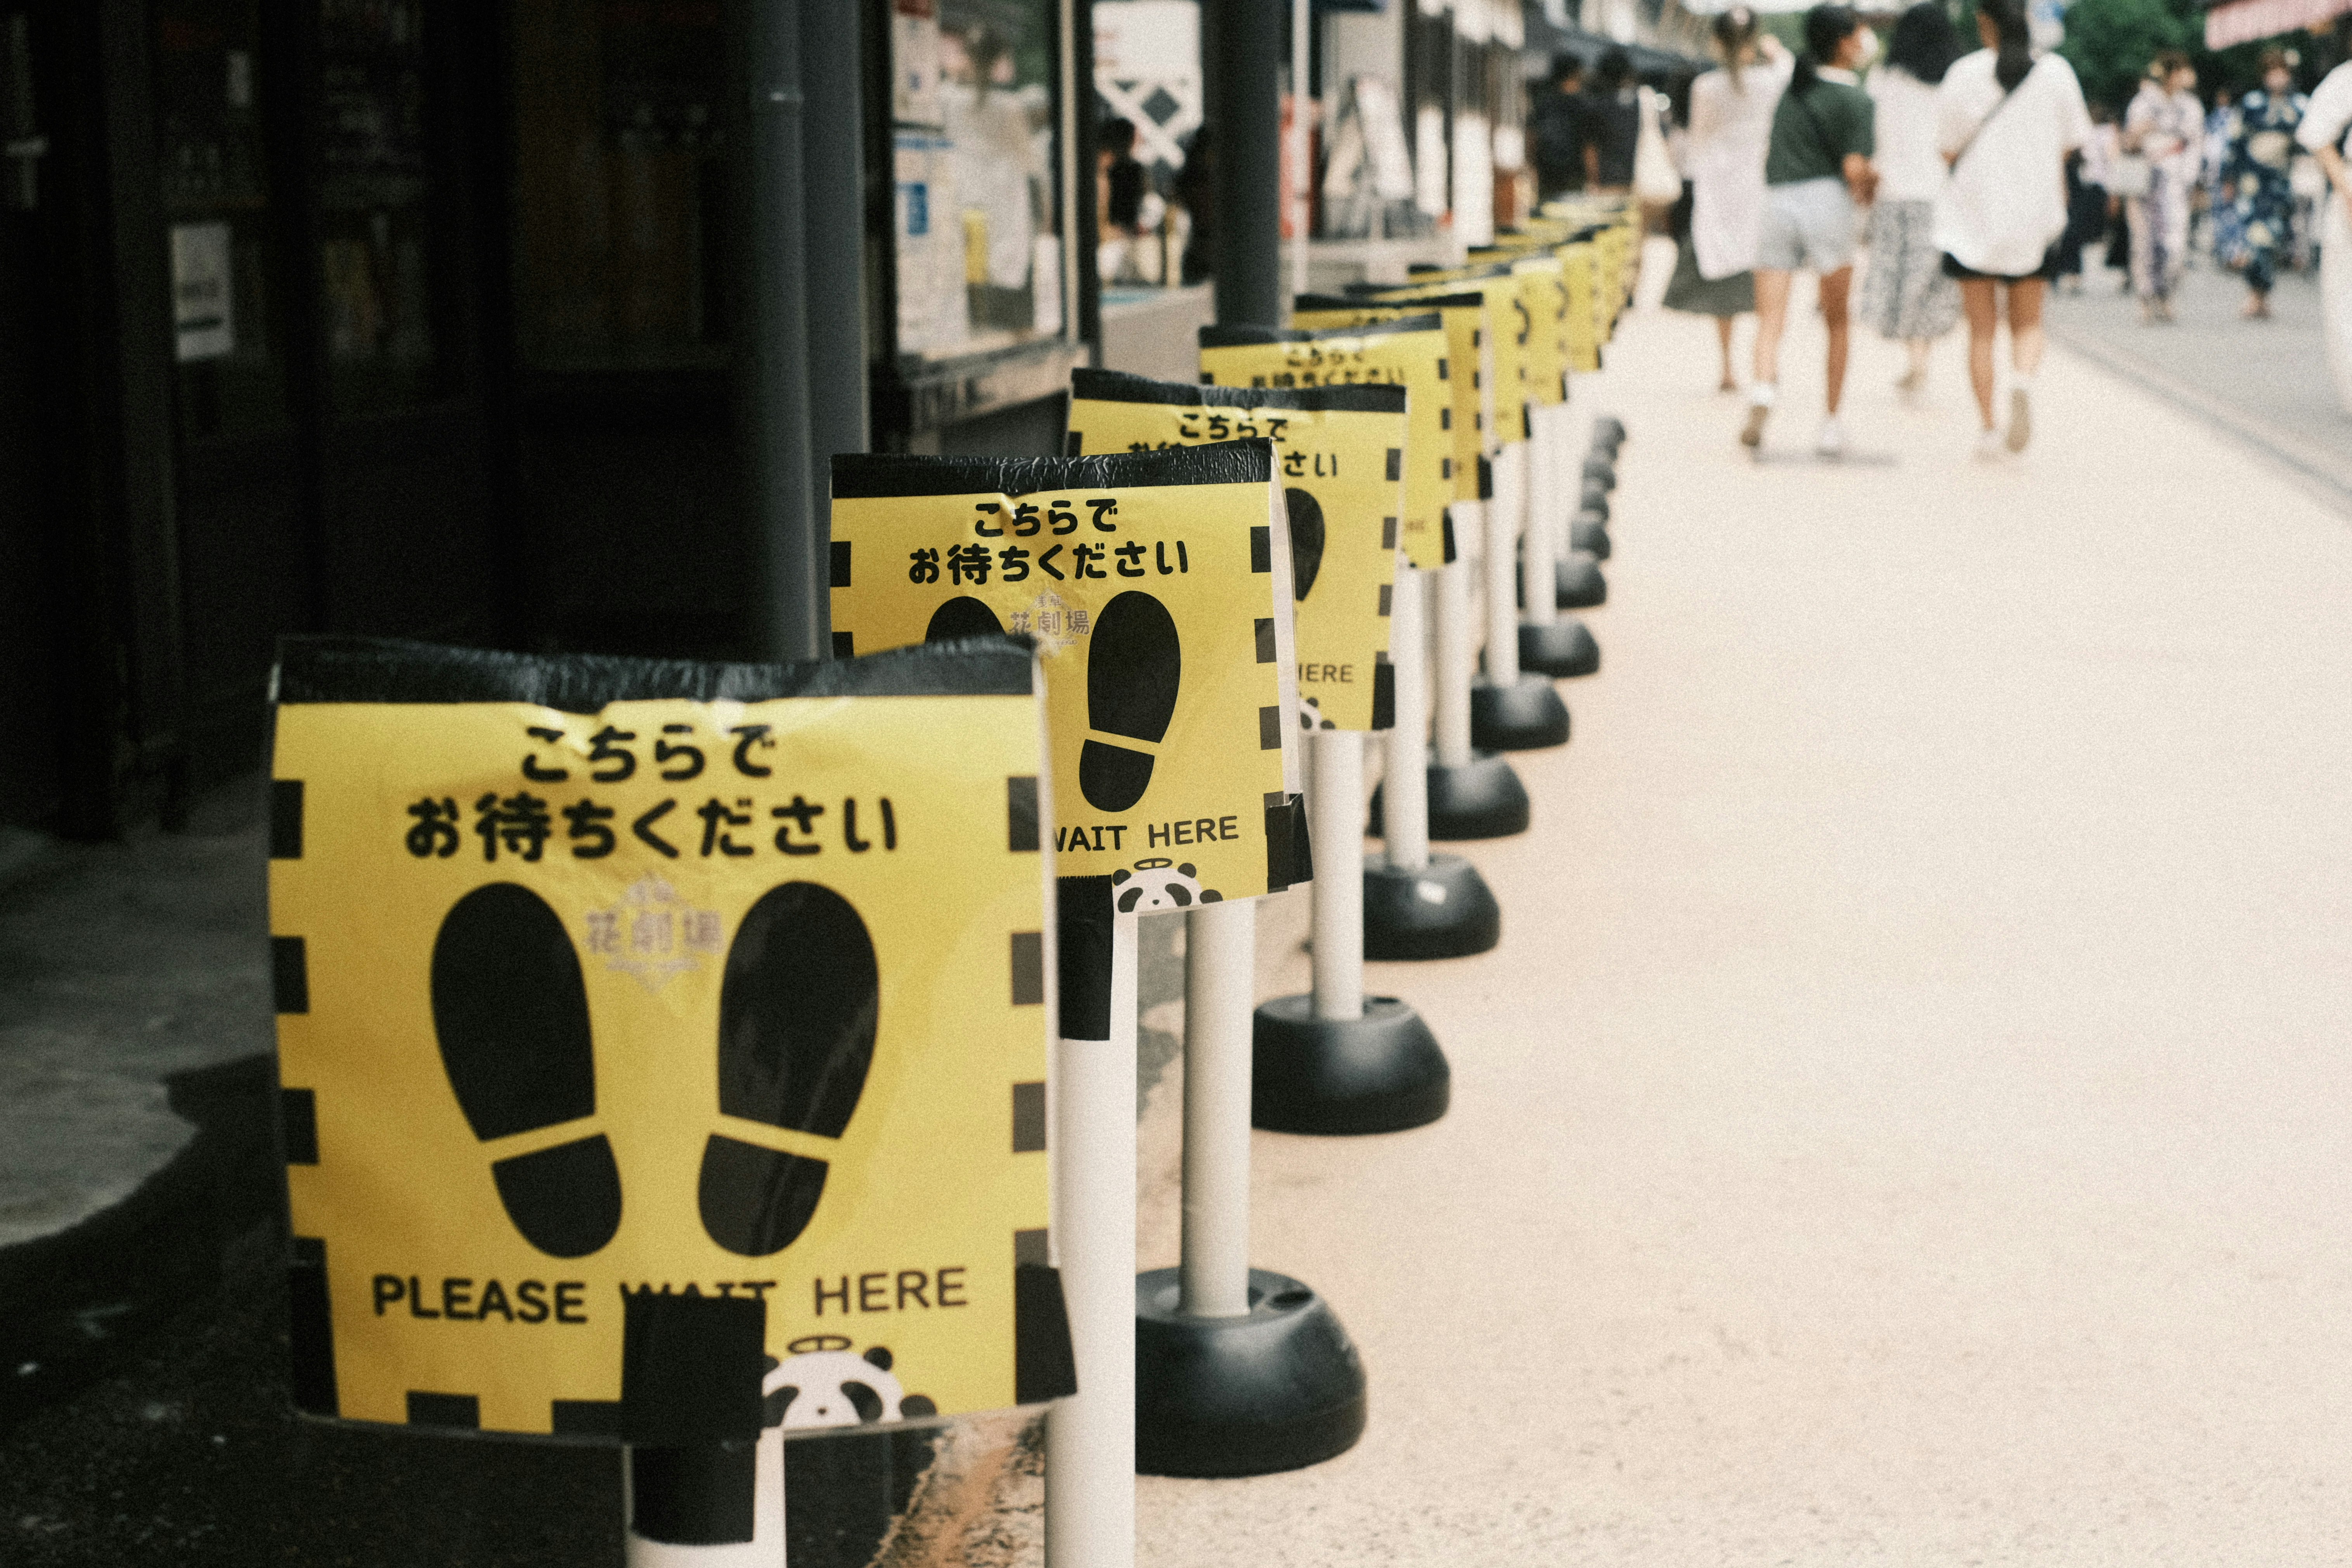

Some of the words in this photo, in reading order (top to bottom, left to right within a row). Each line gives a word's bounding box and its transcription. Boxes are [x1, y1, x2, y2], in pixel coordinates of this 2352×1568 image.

[975, 498, 1118, 537] こちらで
[909, 541, 1188, 586] お待ちください
[1035, 595, 1062, 608] 浅草
[1010, 610, 1090, 636] 花劇場
[1298, 664, 1353, 682] ERE
[521, 724, 776, 783] こちらで
[405, 793, 897, 863] お待ちください
[1148, 816, 1238, 849] HERE
[371, 1272, 589, 1325] PLEASE
[814, 1267, 969, 1317] HERE
